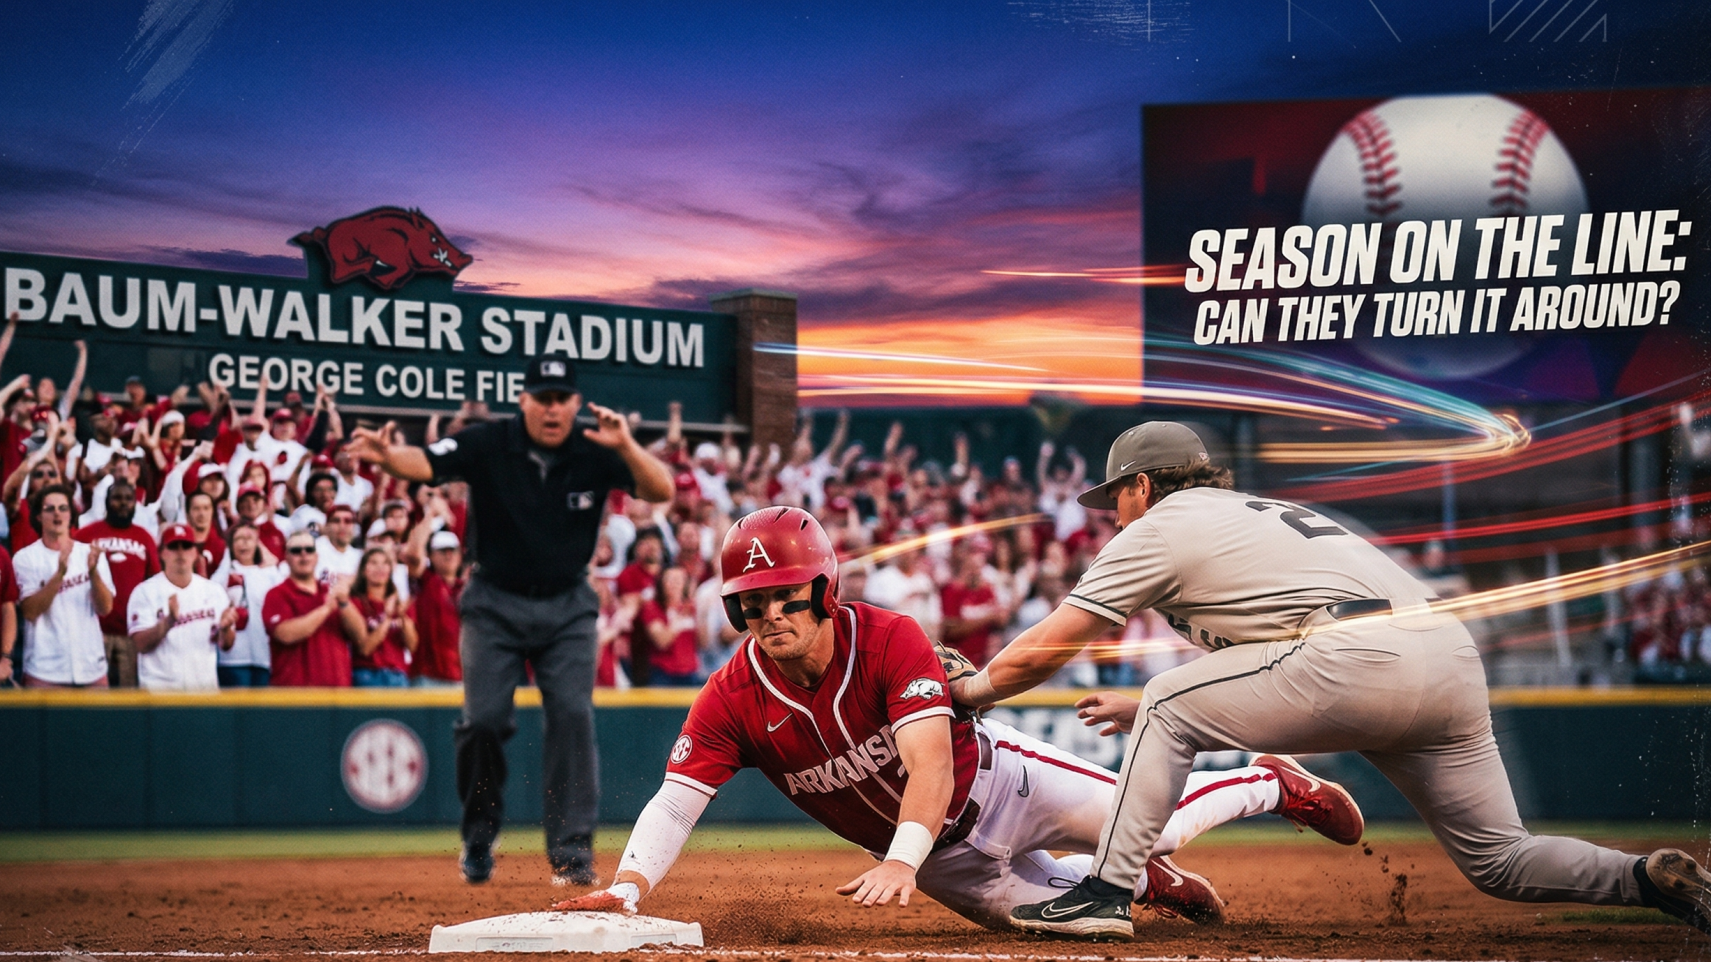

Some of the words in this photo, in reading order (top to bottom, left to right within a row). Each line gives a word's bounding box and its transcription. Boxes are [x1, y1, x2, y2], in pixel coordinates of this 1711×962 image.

[5, 266, 465, 352] BAUM-WALKER
[480, 305, 704, 368] STADIUM
[208, 352, 364, 396] GEORGE
[375, 363, 465, 402] COLE
[476, 370, 525, 404] FIE
[742, 536, 775, 573] A
[783, 724, 898, 796] ARKANSA
